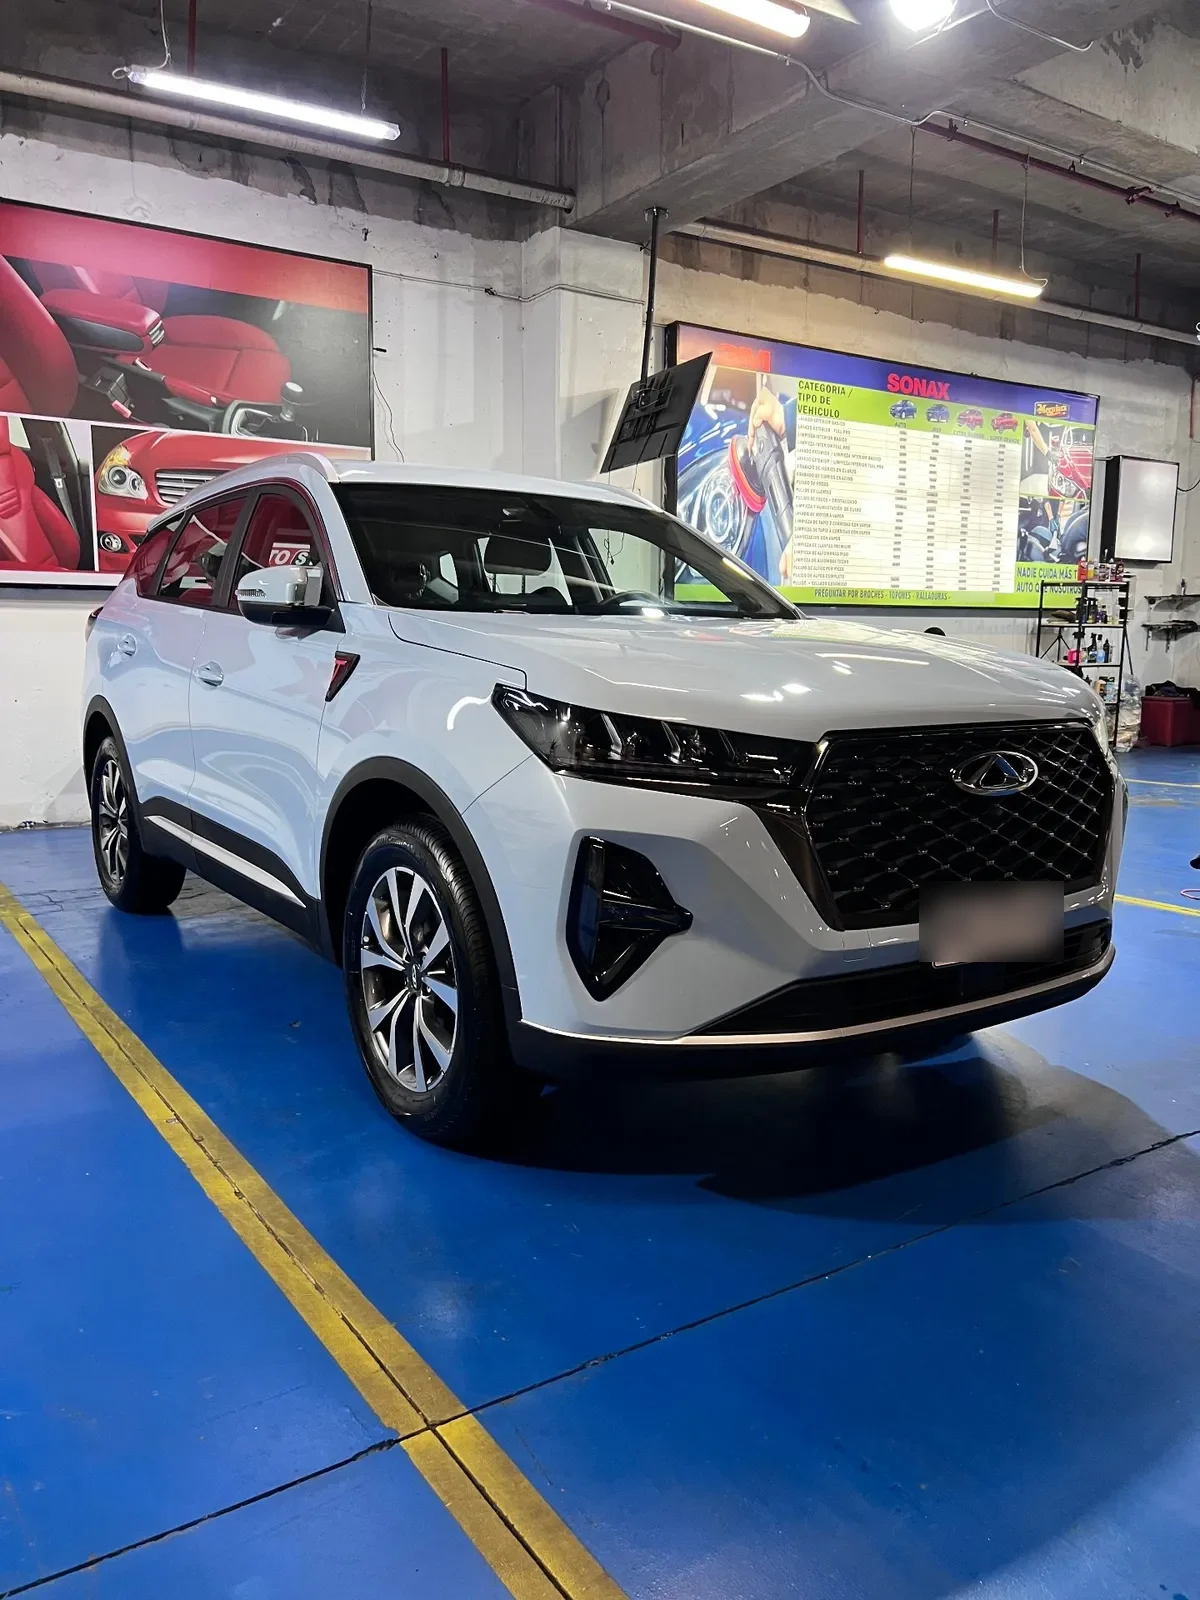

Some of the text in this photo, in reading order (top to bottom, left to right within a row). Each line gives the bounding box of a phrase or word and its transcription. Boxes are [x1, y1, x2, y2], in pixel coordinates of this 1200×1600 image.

[798, 380, 846, 396] CATEGORIA
[887, 373, 950, 400] SONAX
[798, 392, 831, 405] TIPO DE
[797, 405, 840, 418] VEHICULO
[1017, 567, 1036, 578] NADIE
[1039, 569, 1058, 580] CUIDA
[1060, 568, 1072, 579] MÁS
[814, 588, 846, 598] PREGUNTAR
[848, 589, 859, 598] POR
[860, 590, 884, 599] BROCHES
[1016, 582, 1033, 592] AUTO
